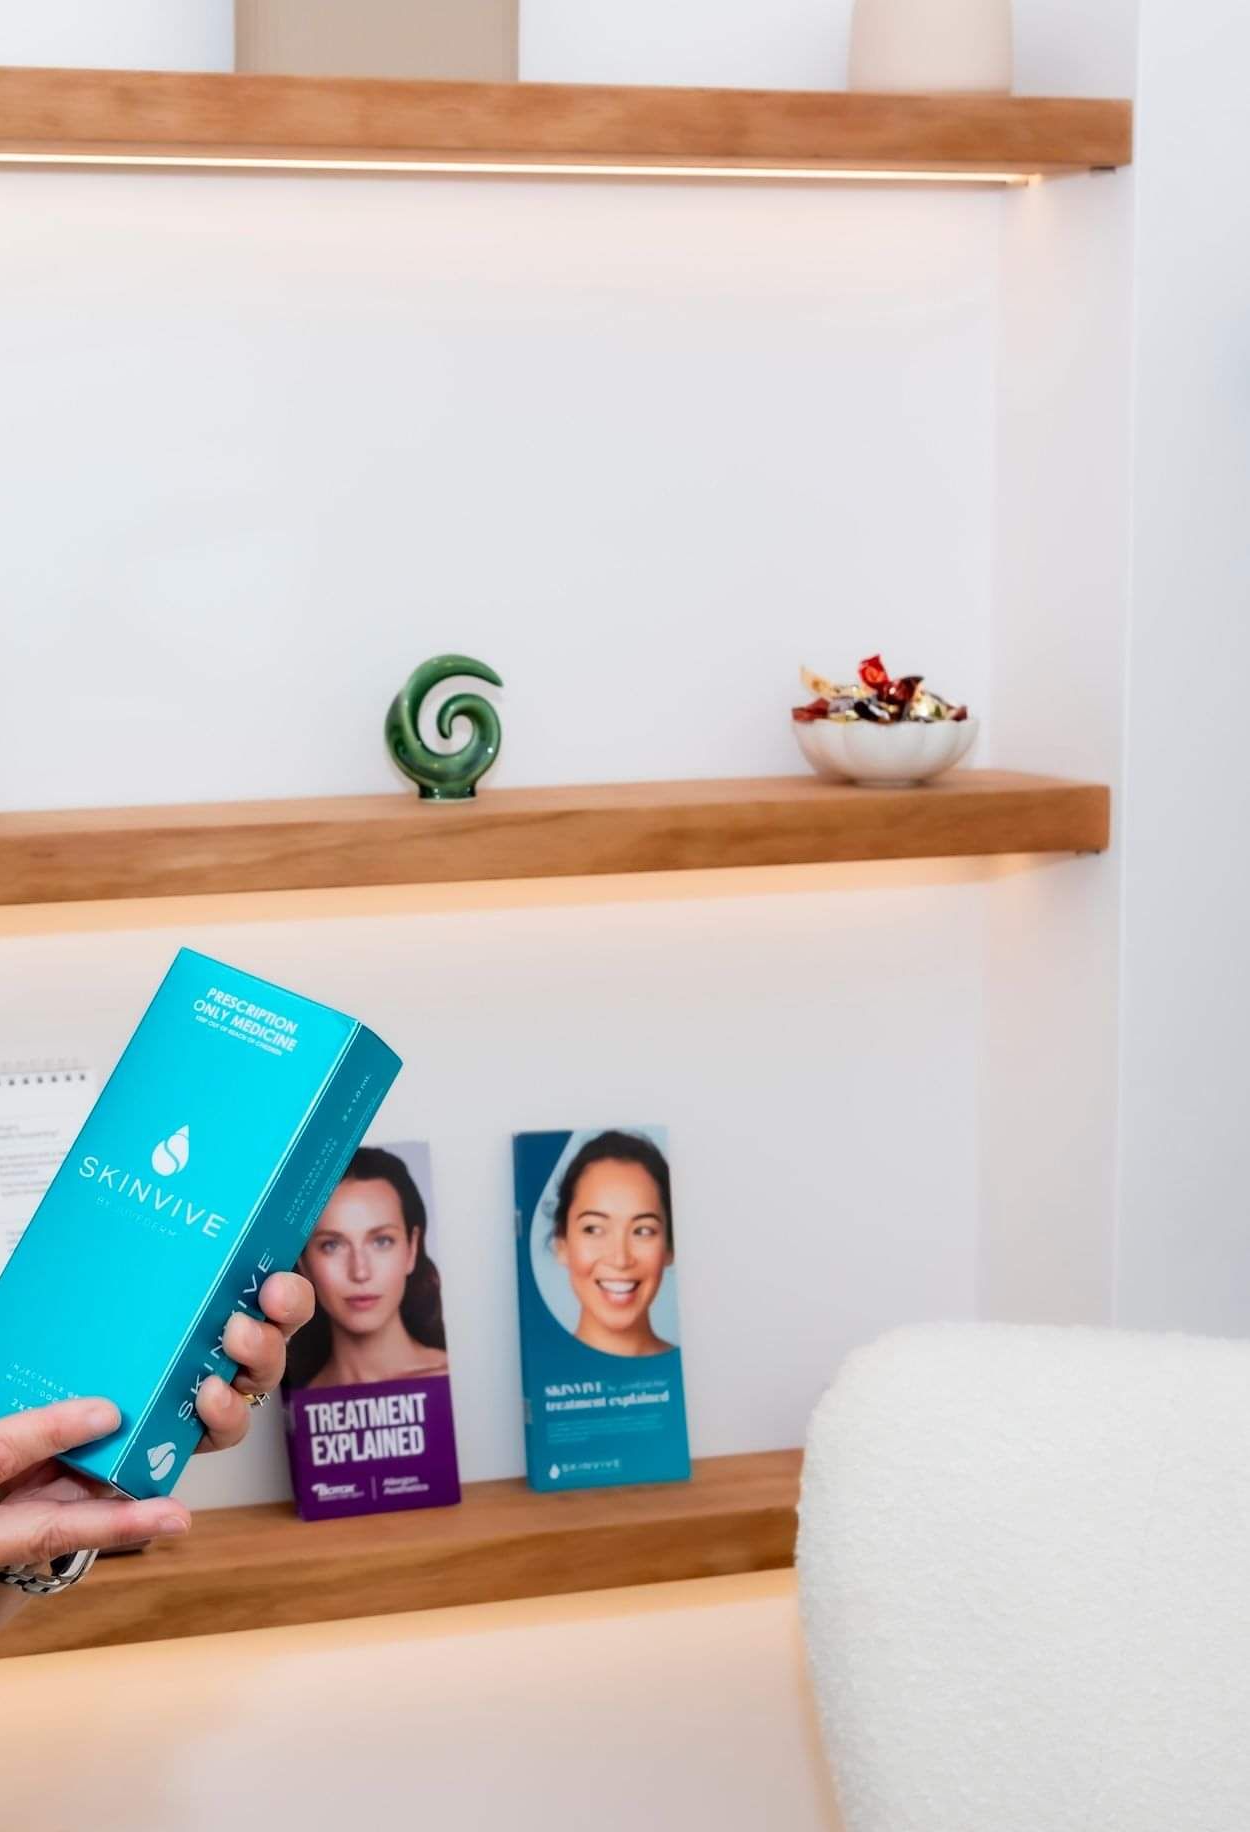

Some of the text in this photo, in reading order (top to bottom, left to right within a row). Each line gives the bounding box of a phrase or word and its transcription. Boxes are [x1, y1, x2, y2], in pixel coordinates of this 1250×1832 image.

[193, 999, 298, 1052] ONLY MEDICINE
[205, 986, 299, 1034] PRESCRIPTION
[78, 1155, 230, 1239] SKINVIVE
[178, 1252, 274, 1421] SKINIVE
[304, 1393, 427, 1434] TREATMENT
[311, 1425, 425, 1466] EXPLAINED
